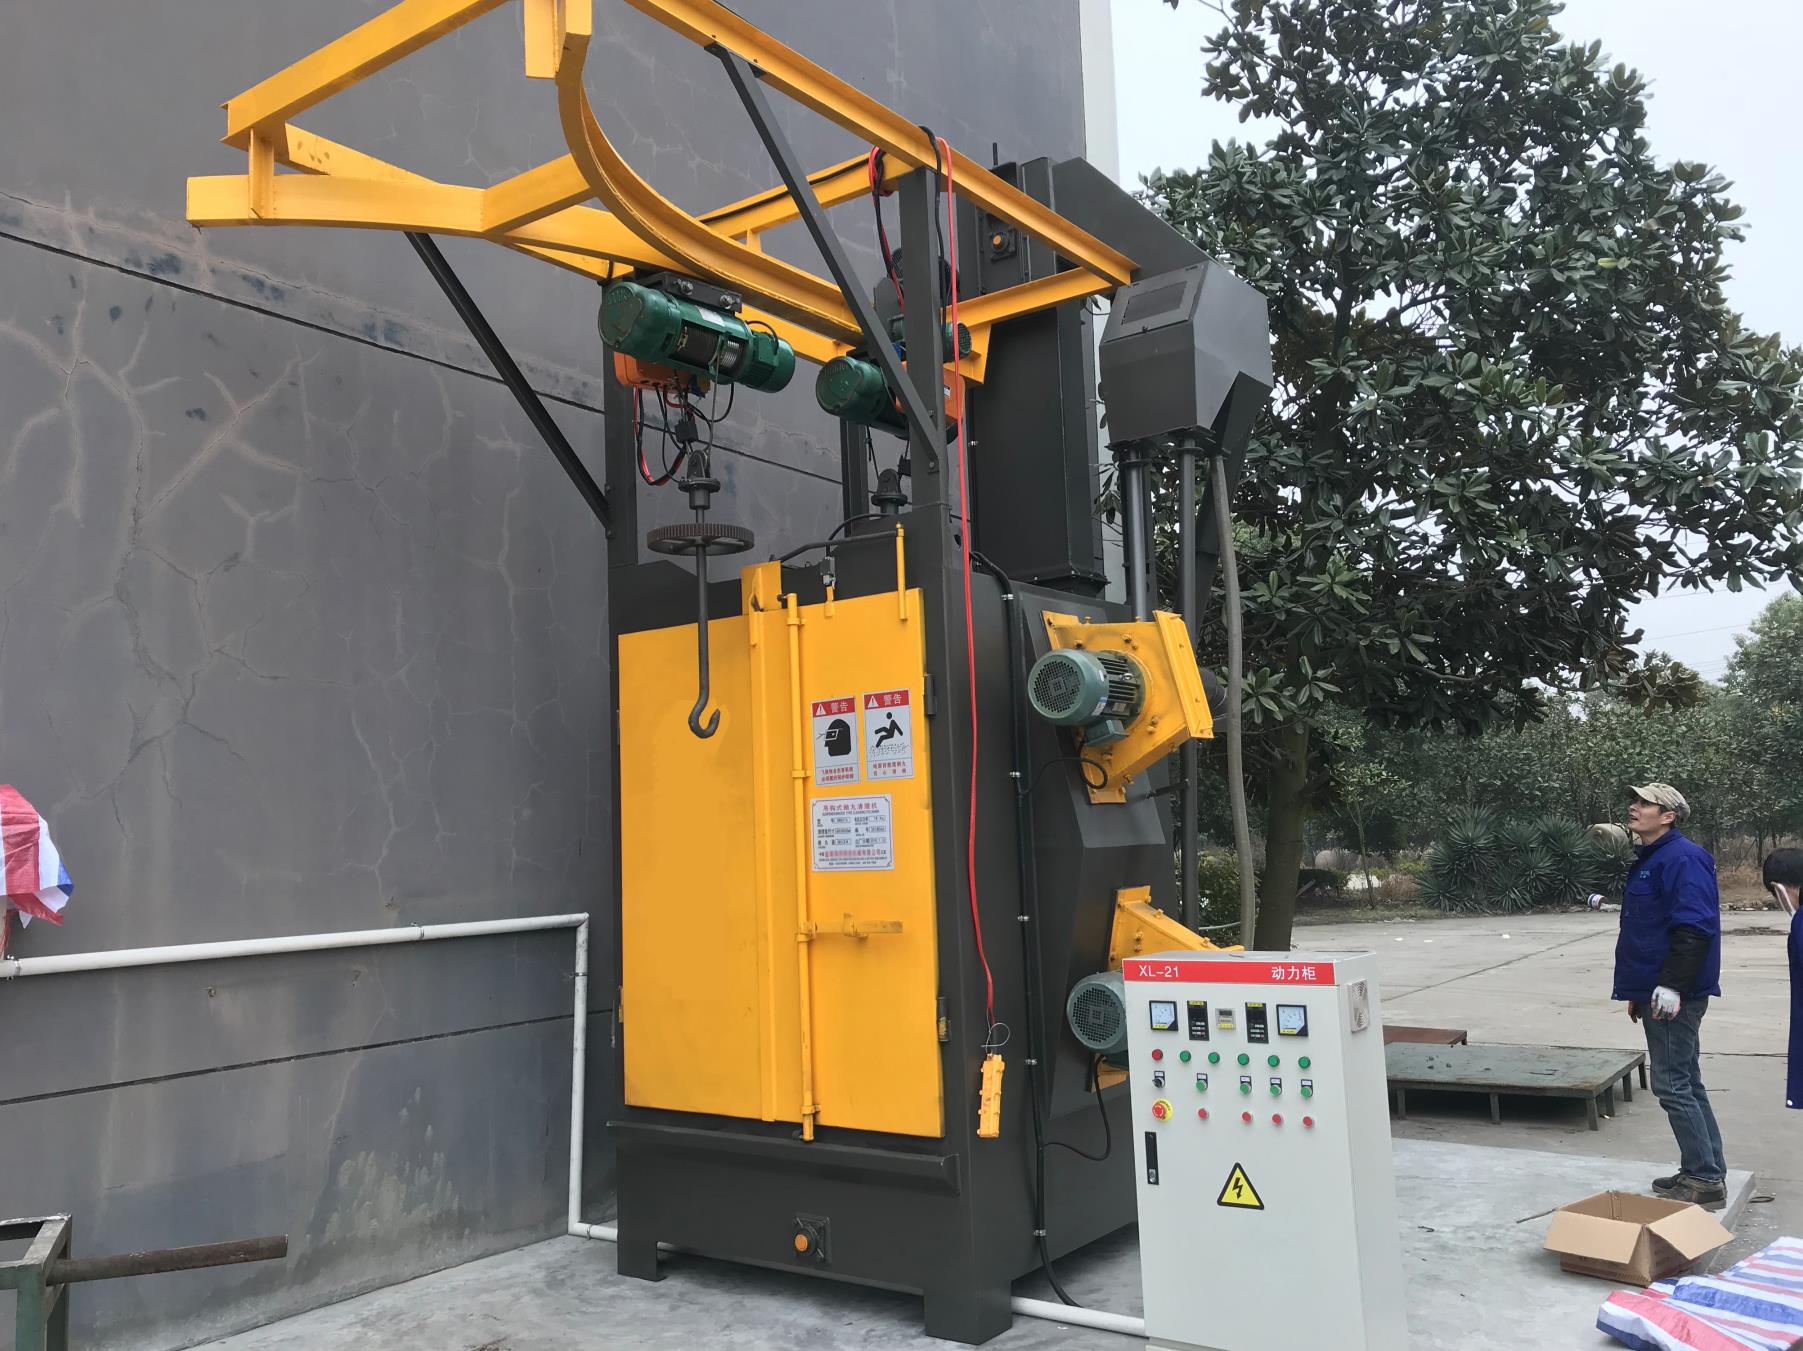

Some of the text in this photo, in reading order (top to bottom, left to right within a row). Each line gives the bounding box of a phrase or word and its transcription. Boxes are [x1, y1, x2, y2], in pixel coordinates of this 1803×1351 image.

[883, 694, 902, 705] 警告
[831, 701, 848, 713] 警告
[1138, 965, 1180, 978] XL-21
[1271, 964, 1317, 981] 动力柜
